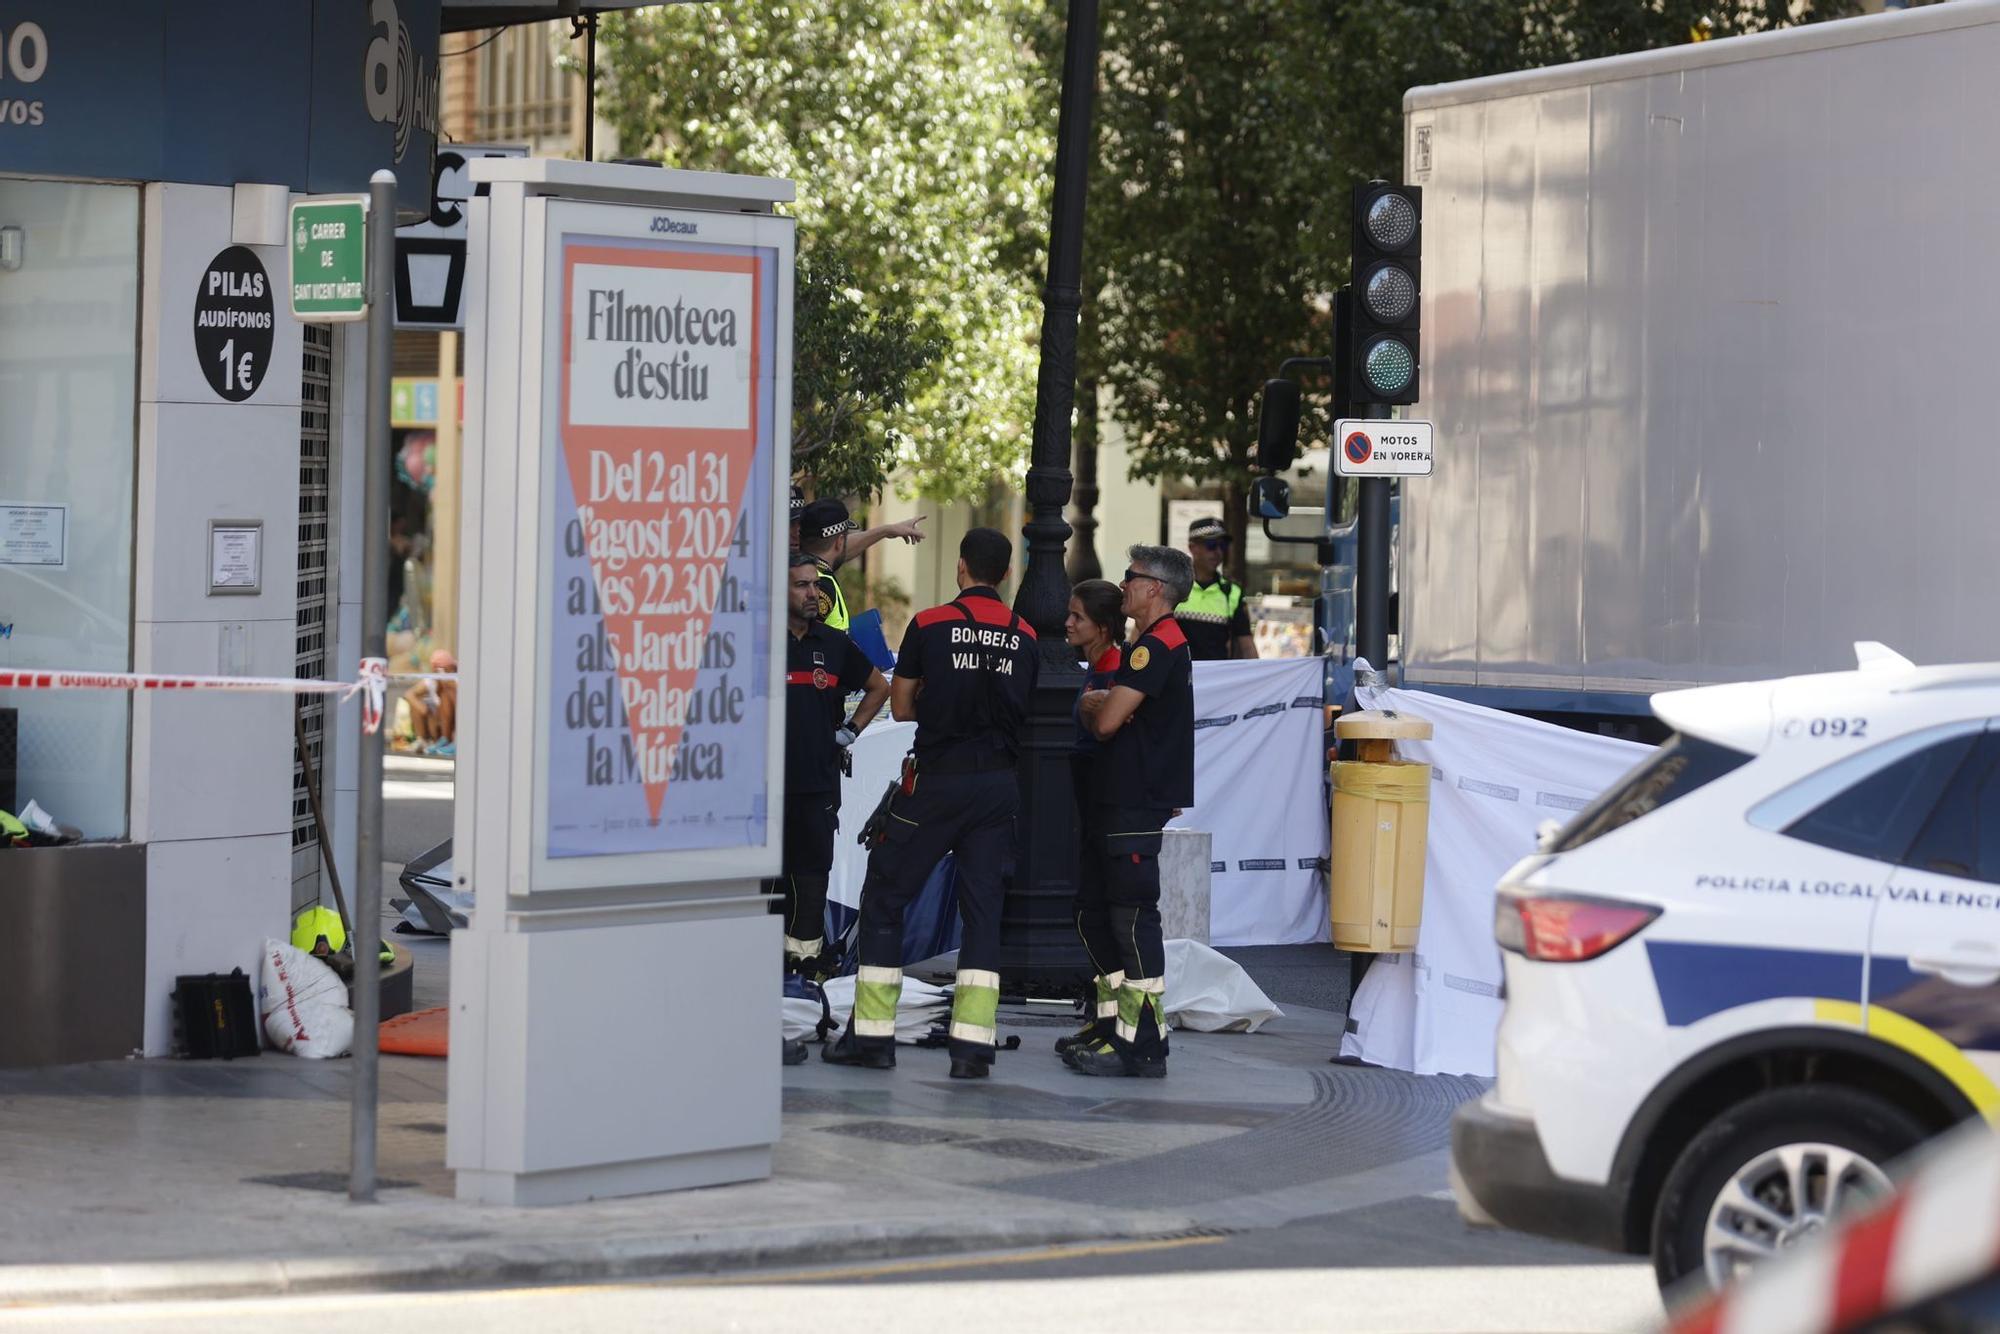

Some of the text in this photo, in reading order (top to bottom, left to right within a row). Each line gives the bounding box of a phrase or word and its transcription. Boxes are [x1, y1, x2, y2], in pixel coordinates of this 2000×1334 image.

[0, 21, 48, 82] o
[311, 222, 346, 240] CARRER
[650, 216, 698, 234] JCDecaux
[321, 250, 334, 267] DE
[208, 271, 264, 298] PILAS
[295, 283, 312, 300] SANT
[312, 282, 336, 299] VICENT
[198, 307, 271, 329] AUDÍFONOS
[586, 289, 737, 347] Filmoteca
[219, 338, 253, 391] 1€
[614, 346, 708, 402] d'estiu
[1373, 451, 1431, 461] EN VORERA
[1380, 436, 1418, 445] MOTOS
[589, 449, 728, 504] Del 2 al 31
[565, 504, 750, 571] d'agost 2024
[567, 575, 586, 616] a
[592, 562, 635, 616] les
[576, 618, 736, 673] als Jardins
[566, 673, 744, 730] del Palau de
[1810, 718, 1868, 738] 092
[586, 731, 724, 786] la Música
[1695, 874, 1790, 893] POLICIA
[1800, 880, 1877, 900] LOCAL
